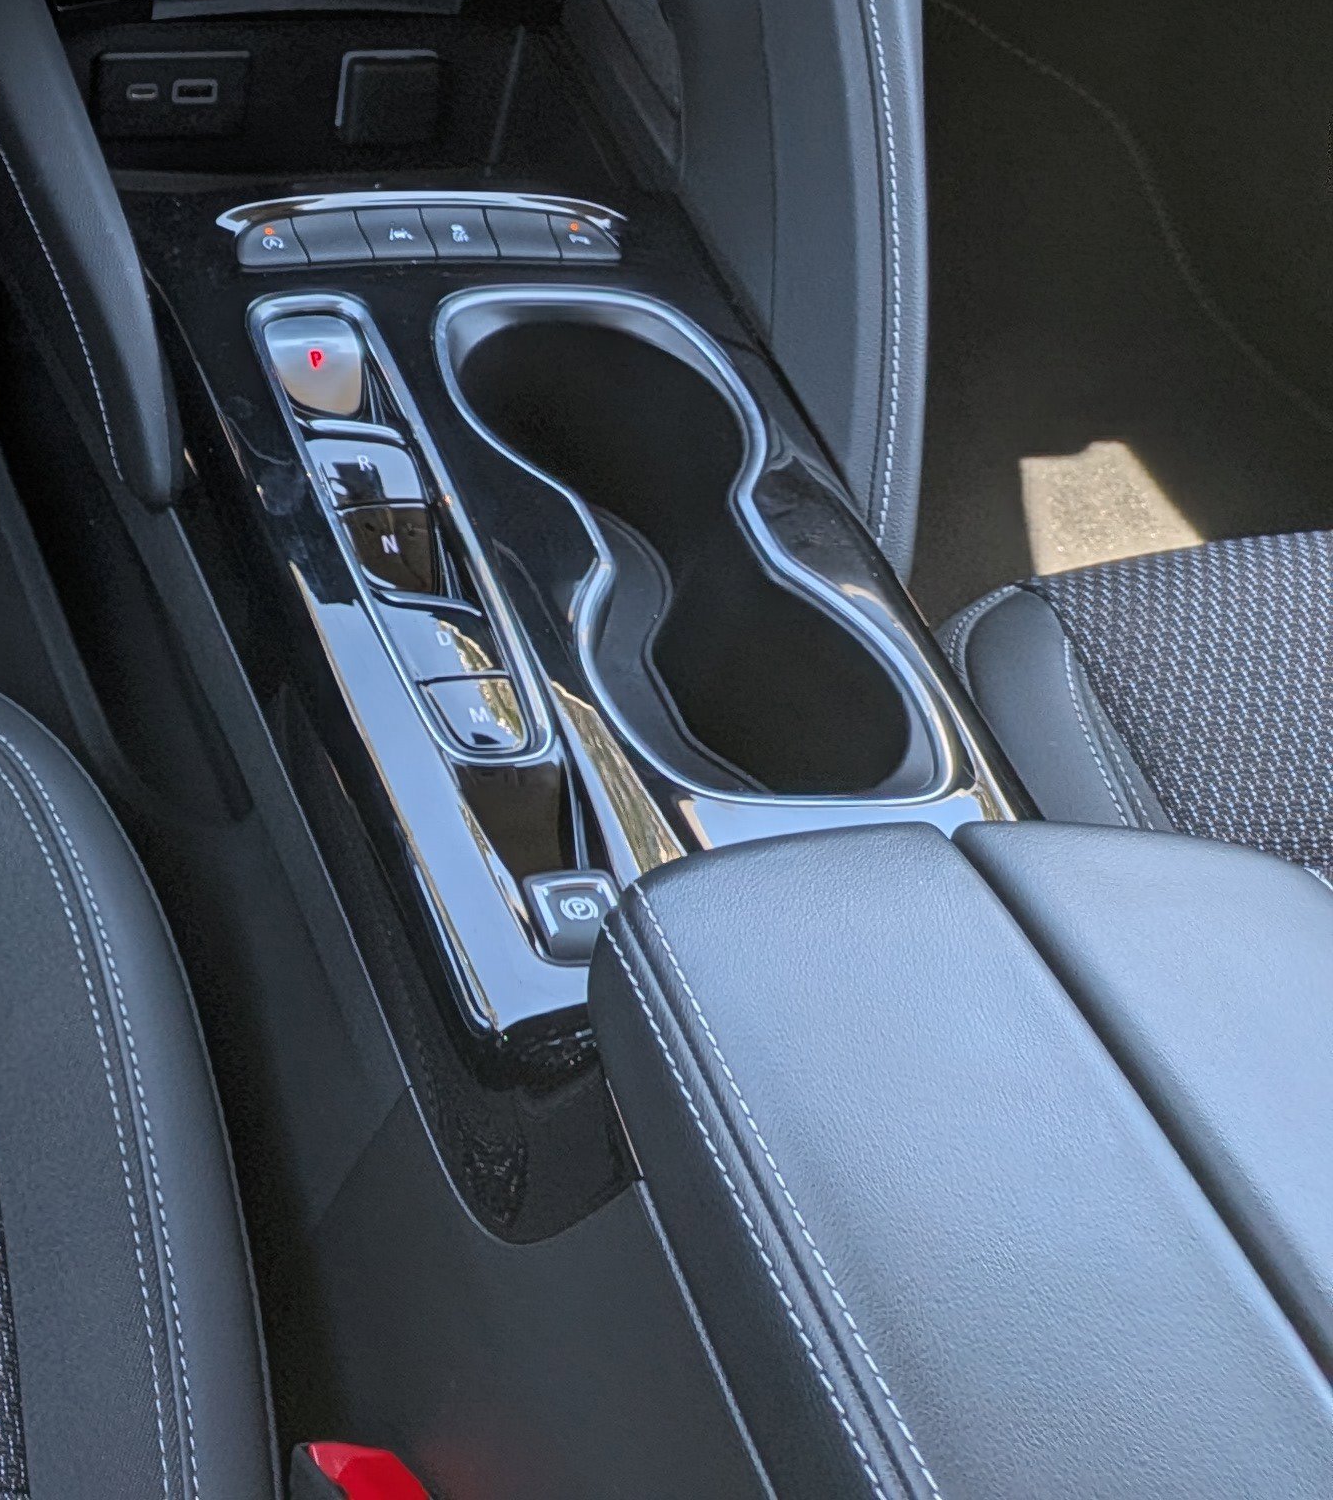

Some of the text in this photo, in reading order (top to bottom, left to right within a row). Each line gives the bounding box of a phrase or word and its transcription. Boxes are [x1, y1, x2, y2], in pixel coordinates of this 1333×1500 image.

[308, 349, 324, 369] P
[357, 455, 373, 471] R
[381, 535, 400, 554] N
[436, 631, 452, 647] D
[469, 707, 490, 725] M
